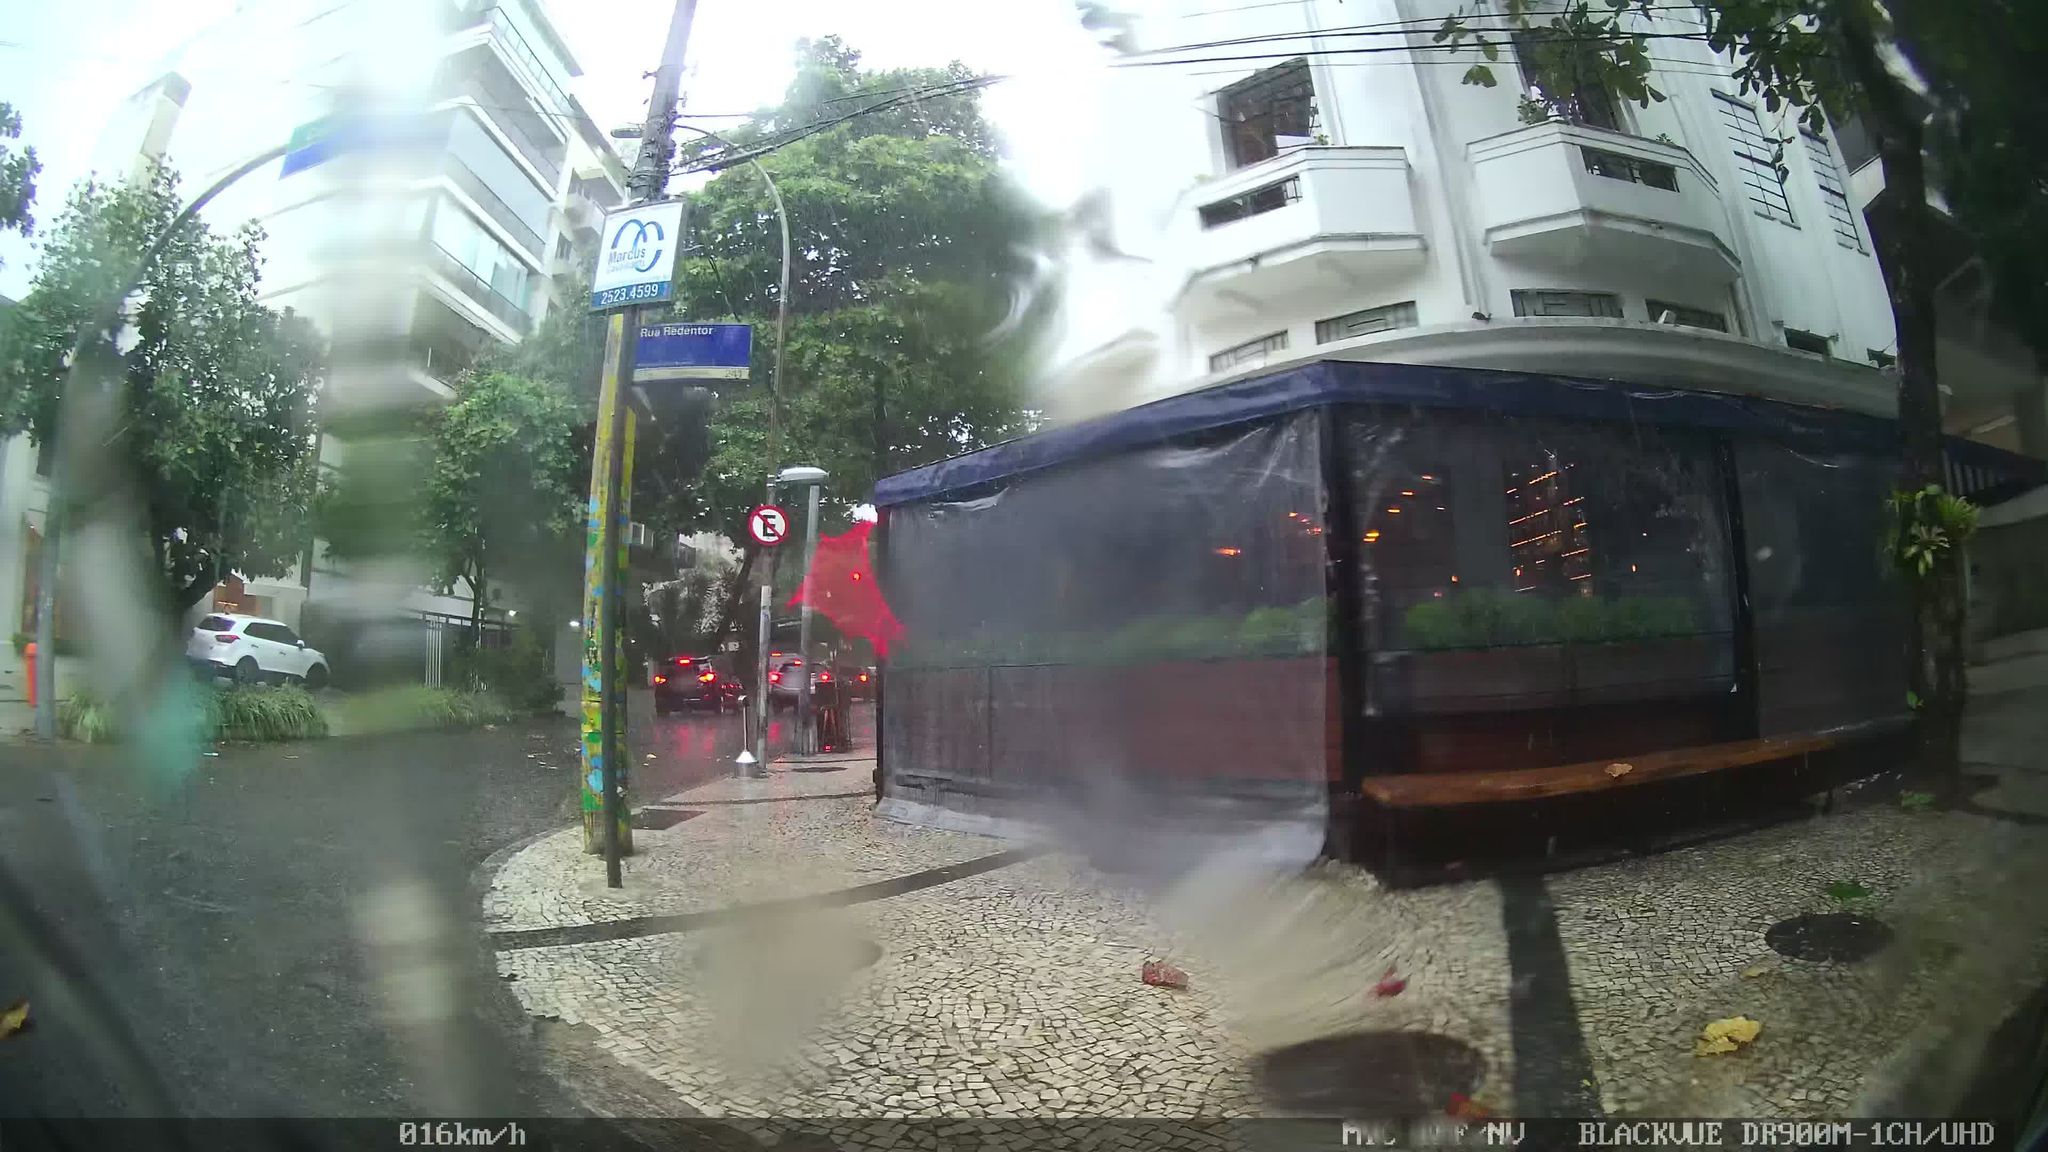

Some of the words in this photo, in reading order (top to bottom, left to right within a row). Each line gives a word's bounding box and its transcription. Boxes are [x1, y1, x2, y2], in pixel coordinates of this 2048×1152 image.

[607, 247, 646, 265] Marcus
[601, 283, 659, 305] 2523.4599
[640, 328, 661, 338] Rua
[663, 326, 714, 336] Redentor
[762, 514, 776, 537] E
